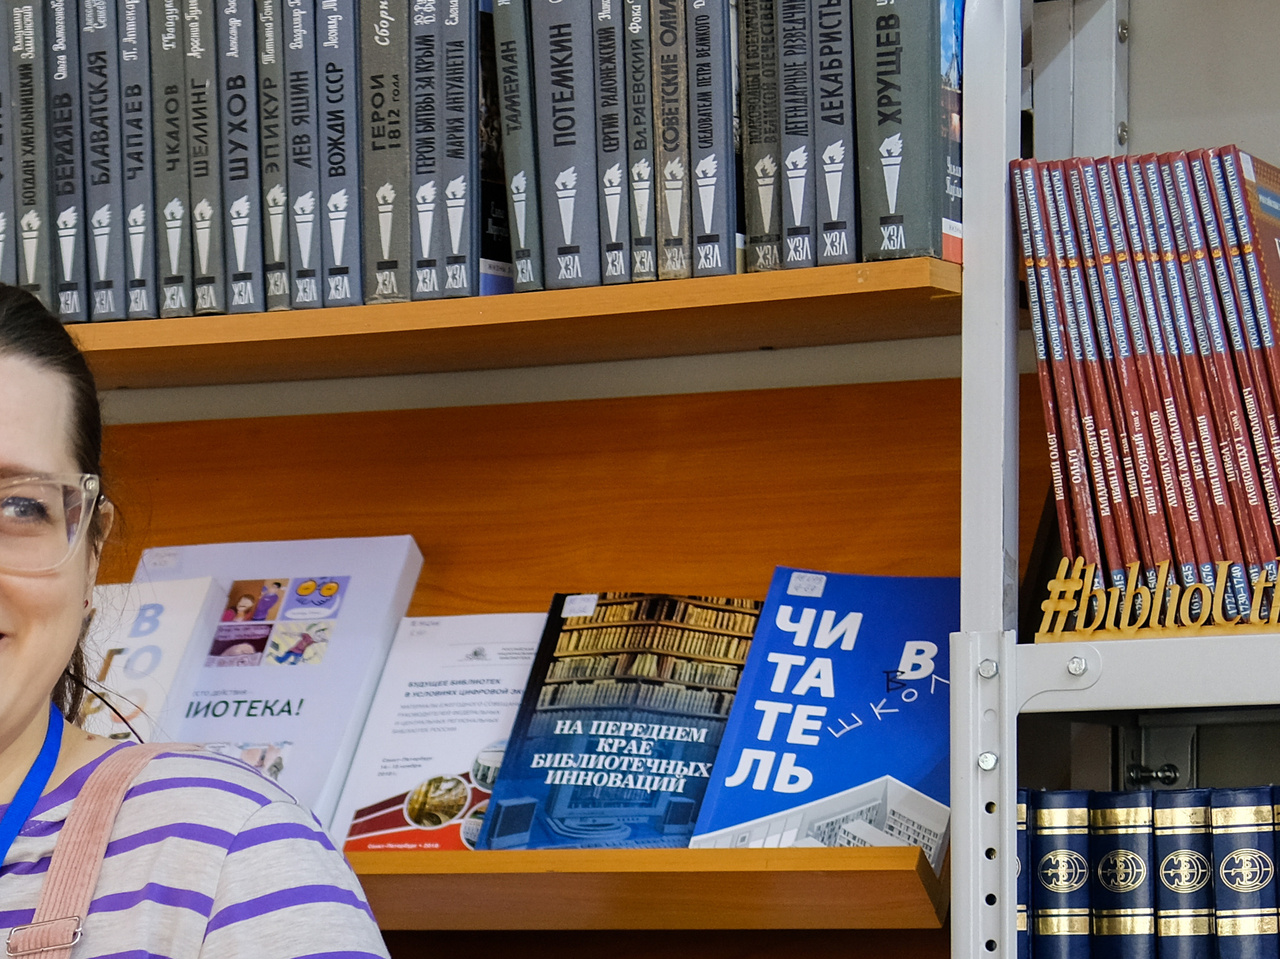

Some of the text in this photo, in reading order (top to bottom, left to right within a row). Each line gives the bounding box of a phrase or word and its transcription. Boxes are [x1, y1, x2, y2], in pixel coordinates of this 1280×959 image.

[628, 4, 643, 34] Фока
[414, 34, 436, 74] КРЫМ
[415, 75, 436, 92] ЗА
[500, 40, 523, 137] ТАМЕРЛАН
[549, 23, 577, 148] ПОТЕМКИН
[694, 14, 714, 150] СЛЕДОВАТЕЛИ ПЕТРА ВЕЛИКОГО
[875, 13, 904, 127] ХРУЩЕВ
[18, 63, 36, 157] ХМЕЛЬНИЦКИЙ
[86, 50, 111, 187] БЛАВАТСКАЯ
[289, 70, 314, 170] ЛЕВ ЯШИН
[325, 62, 347, 178] ВОЖДИ СССР
[369, 74, 402, 151] ГЕРОИ 1812
[415, 92, 437, 134] БИТВЫ
[445, 40, 466, 160] МАРИЯ АНТУАНЕТТА
[596, 26, 620, 154] СЕРГИЙ РАДОНЕЖСКИЙ
[660, 53, 681, 154] СОВЕТСКИЕ
[783, 61, 809, 138] ЛЕГЕНДАРНЫЕ
[52, 92, 75, 197] БЕРДЯЕВ
[125, 83, 144, 181] ЧАПАЕВ
[164, 84, 180, 172] ЧКАЛОВ
[191, 78, 209, 179] ШЕЛЛИНГ
[226, 74, 250, 182] ШУХОВ
[262, 77, 280, 175] ЭПИКУР
[415, 136, 437, 176] ГЕРОИ
[557, 254, 584, 281] ЖЗЛ
[697, 242, 722, 270] ЖЗЛ
[786, 235, 812, 263] ЖЗЛ
[880, 224, 907, 251] ЖЗЛ
[327, 275, 351, 300] ЖЗЛ
[1099, 428, 1116, 469] КАЛИТА
[1242, 387, 1266, 456] НИКОЛАЕВИЧ
[1046, 432, 1065, 501] ВЕЩИЙ ОЛЕГ
[1068, 449, 1082, 484] ОЛЬГА
[1082, 414, 1111, 517] ВЛАДИМИР СВЯТОЙ
[1132, 433, 1158, 516] ИВАН ГРОЗНЫЙ
[1149, 410, 1178, 508] МИХАИЛ РОМАНОВ
[1163, 396, 1200, 522] АЛЕКСЕЙ МИХАЙЛОВИЧ
[1189, 450, 1205, 480] ПЕТР
[1235, 443, 1261, 507] АЛЕКСАНДР
[775, 604, 864, 651] ЧИ
[896, 640, 938, 680] В
[767, 652, 835, 698] ТА
[554, 720, 708, 743] НА ПЕРЕДНЕМ
[596, 738, 655, 756] КРАЕ
[754, 699, 828, 746] ТЕ
[530, 753, 713, 778] БИБЛИОТЕЧНЫХ
[544, 770, 687, 794] ИННОВАЦИЙ
[724, 748, 814, 794] ЛЬ
